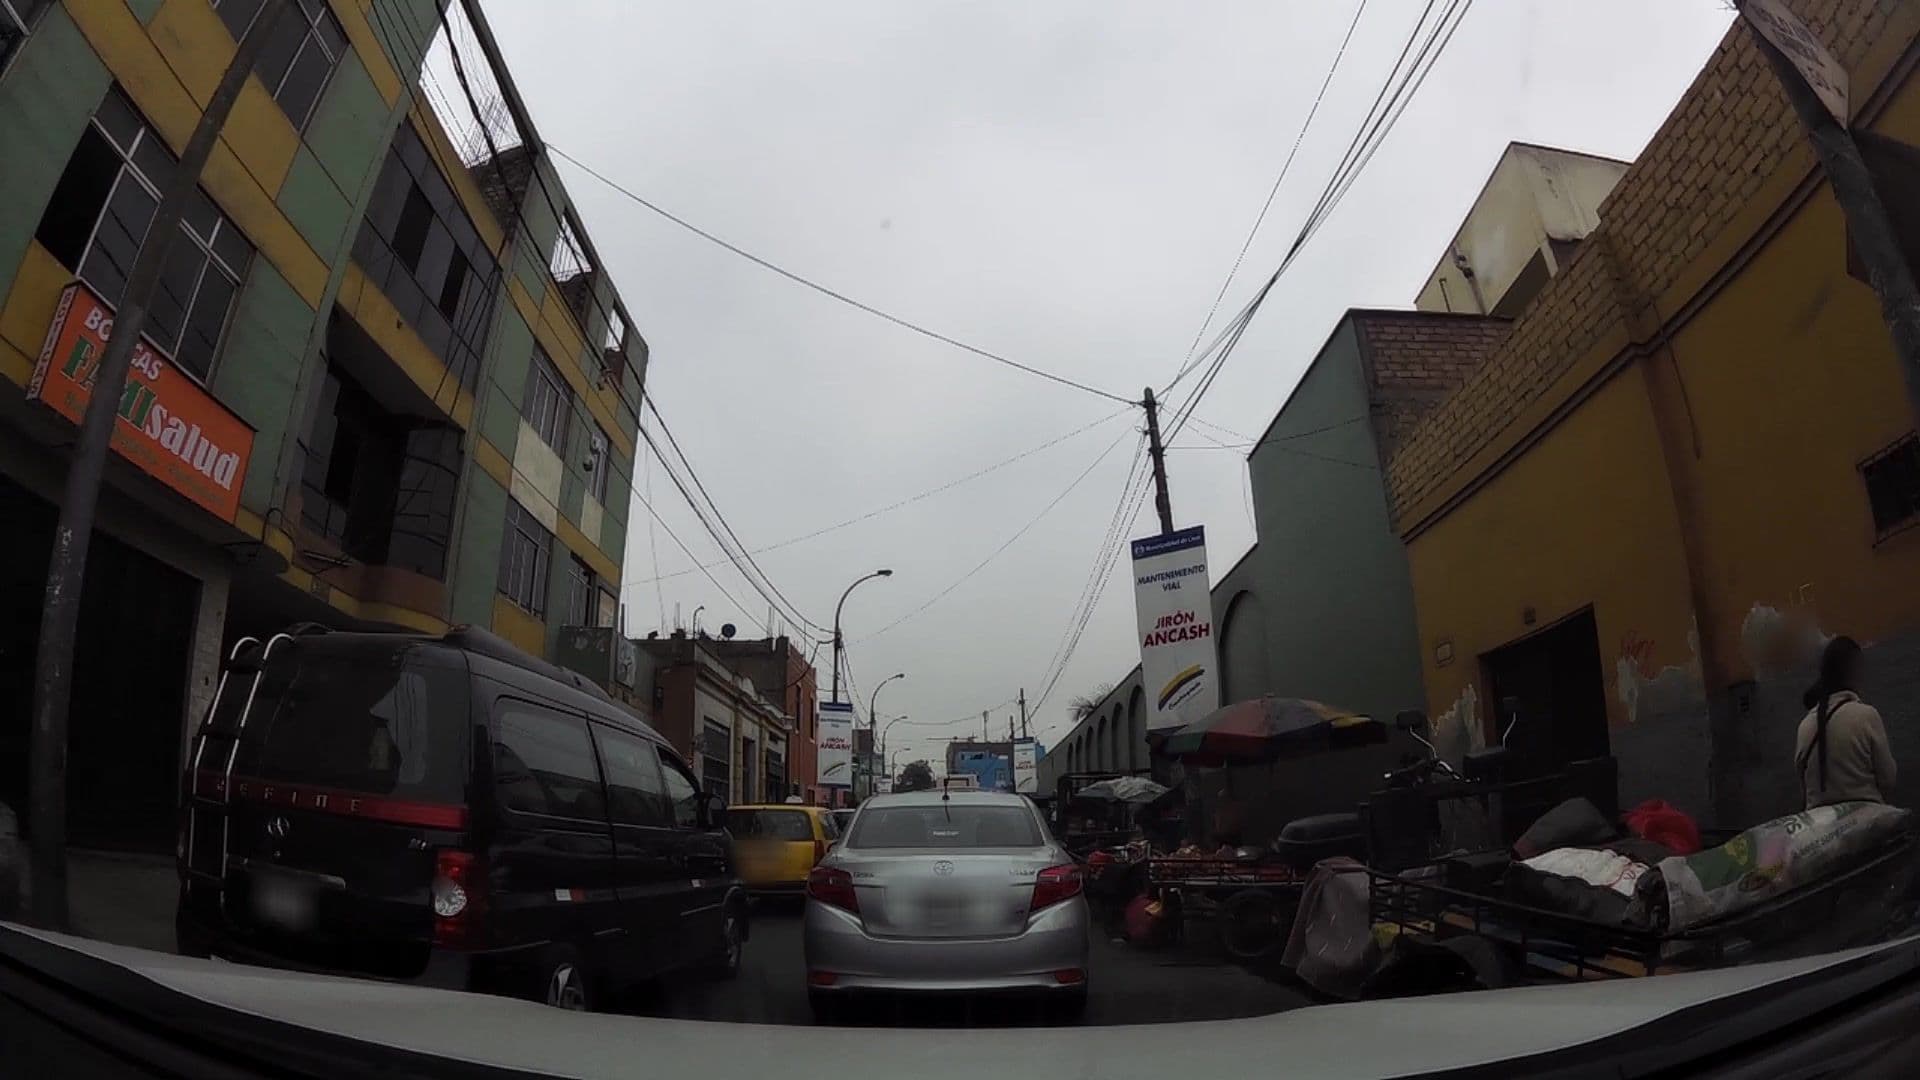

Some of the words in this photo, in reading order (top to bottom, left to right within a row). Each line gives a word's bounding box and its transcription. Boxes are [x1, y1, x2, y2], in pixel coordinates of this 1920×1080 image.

[84, 306, 163, 381] BOAS
[1137, 564, 1206, 585] MANTENIMIENTO
[1162, 581, 1182, 592] VIAL
[1155, 610, 1195, 629] JIRÓN
[1143, 622, 1210, 649] ANCASH
